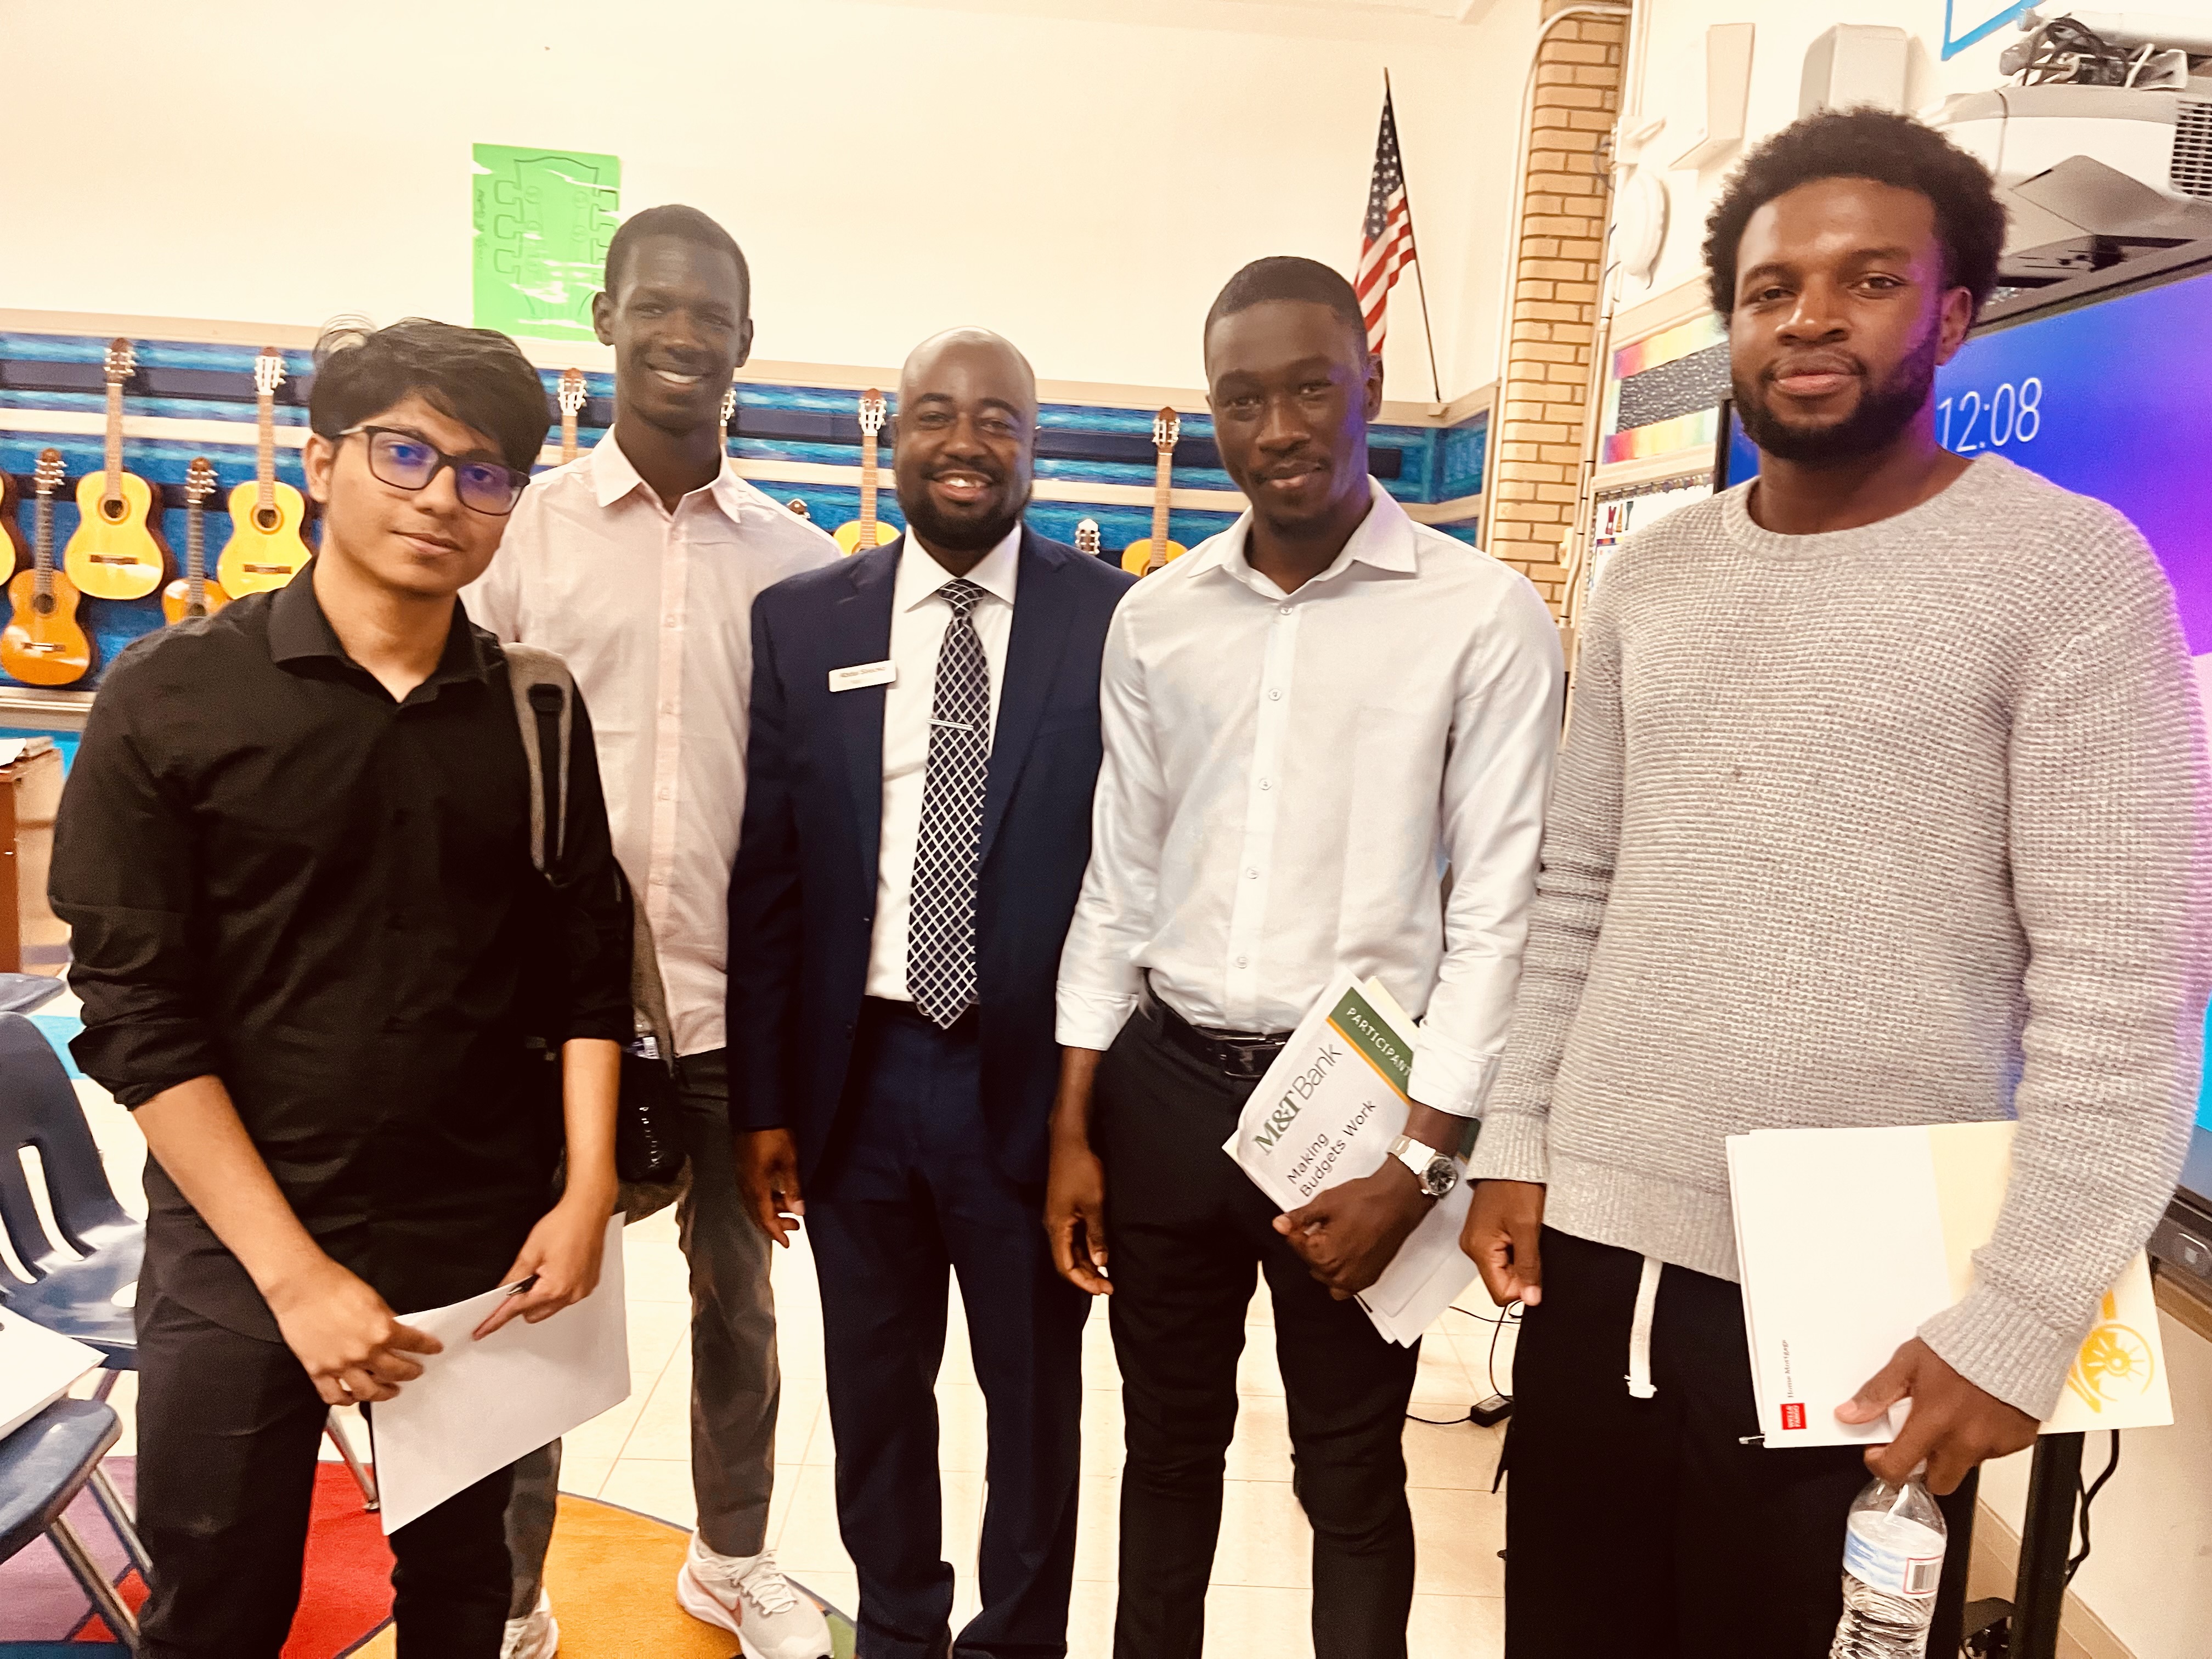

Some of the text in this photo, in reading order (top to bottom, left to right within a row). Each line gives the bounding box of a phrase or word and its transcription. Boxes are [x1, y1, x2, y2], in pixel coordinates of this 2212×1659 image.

[1938, 377, 2042, 452] 12:08
[1251, 1044, 1343, 1156] M&T Bank
[1286, 1133, 1329, 1184] Making
[1299, 1101, 1377, 1197] Budgets Work
